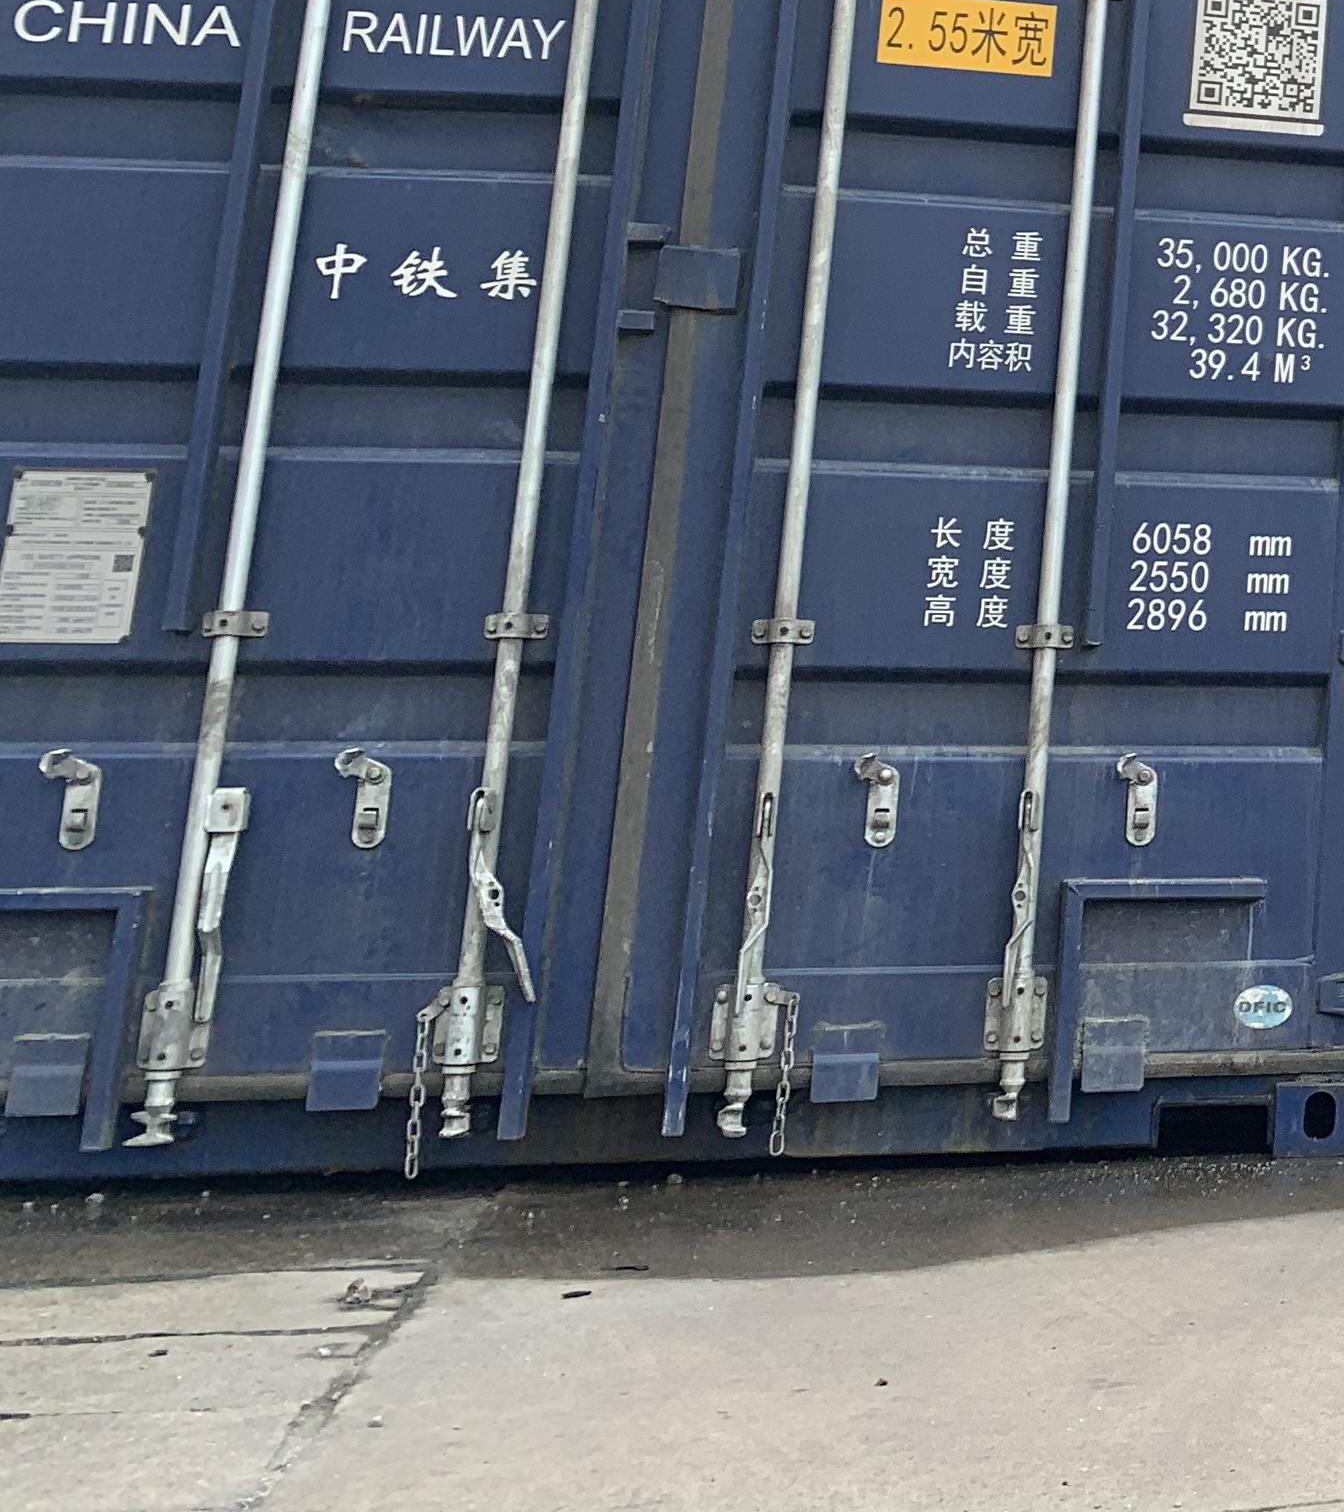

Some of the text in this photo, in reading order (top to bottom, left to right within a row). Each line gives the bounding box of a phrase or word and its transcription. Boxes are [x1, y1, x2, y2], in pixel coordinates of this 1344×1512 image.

[14, 0, 566, 60] CHINA RAILWAY
[961, 227, 1043, 262] 总重
[1156, 237, 1330, 278] 35,000 KG.
[314, 241, 538, 301] 中铁集
[961, 263, 1040, 298] 自重
[1172, 274, 1327, 314] 2,680 KG.
[954, 299, 1036, 335] 载重
[1151, 309, 1325, 349] 32,320 KG.
[948, 337, 1032, 372] 内容积
[1189, 348, 1261, 382] 39.4
[930, 516, 1015, 551] 长度
[1132, 522, 1292, 557] 6058 mm
[926, 554, 1012, 590] 宽度
[1129, 559, 1290, 594] 2550 mm
[923, 593, 1009, 628] 高度
[1126, 597, 1287, 632] 2896 mm
[1238, 1000, 1287, 1014] DFIC
